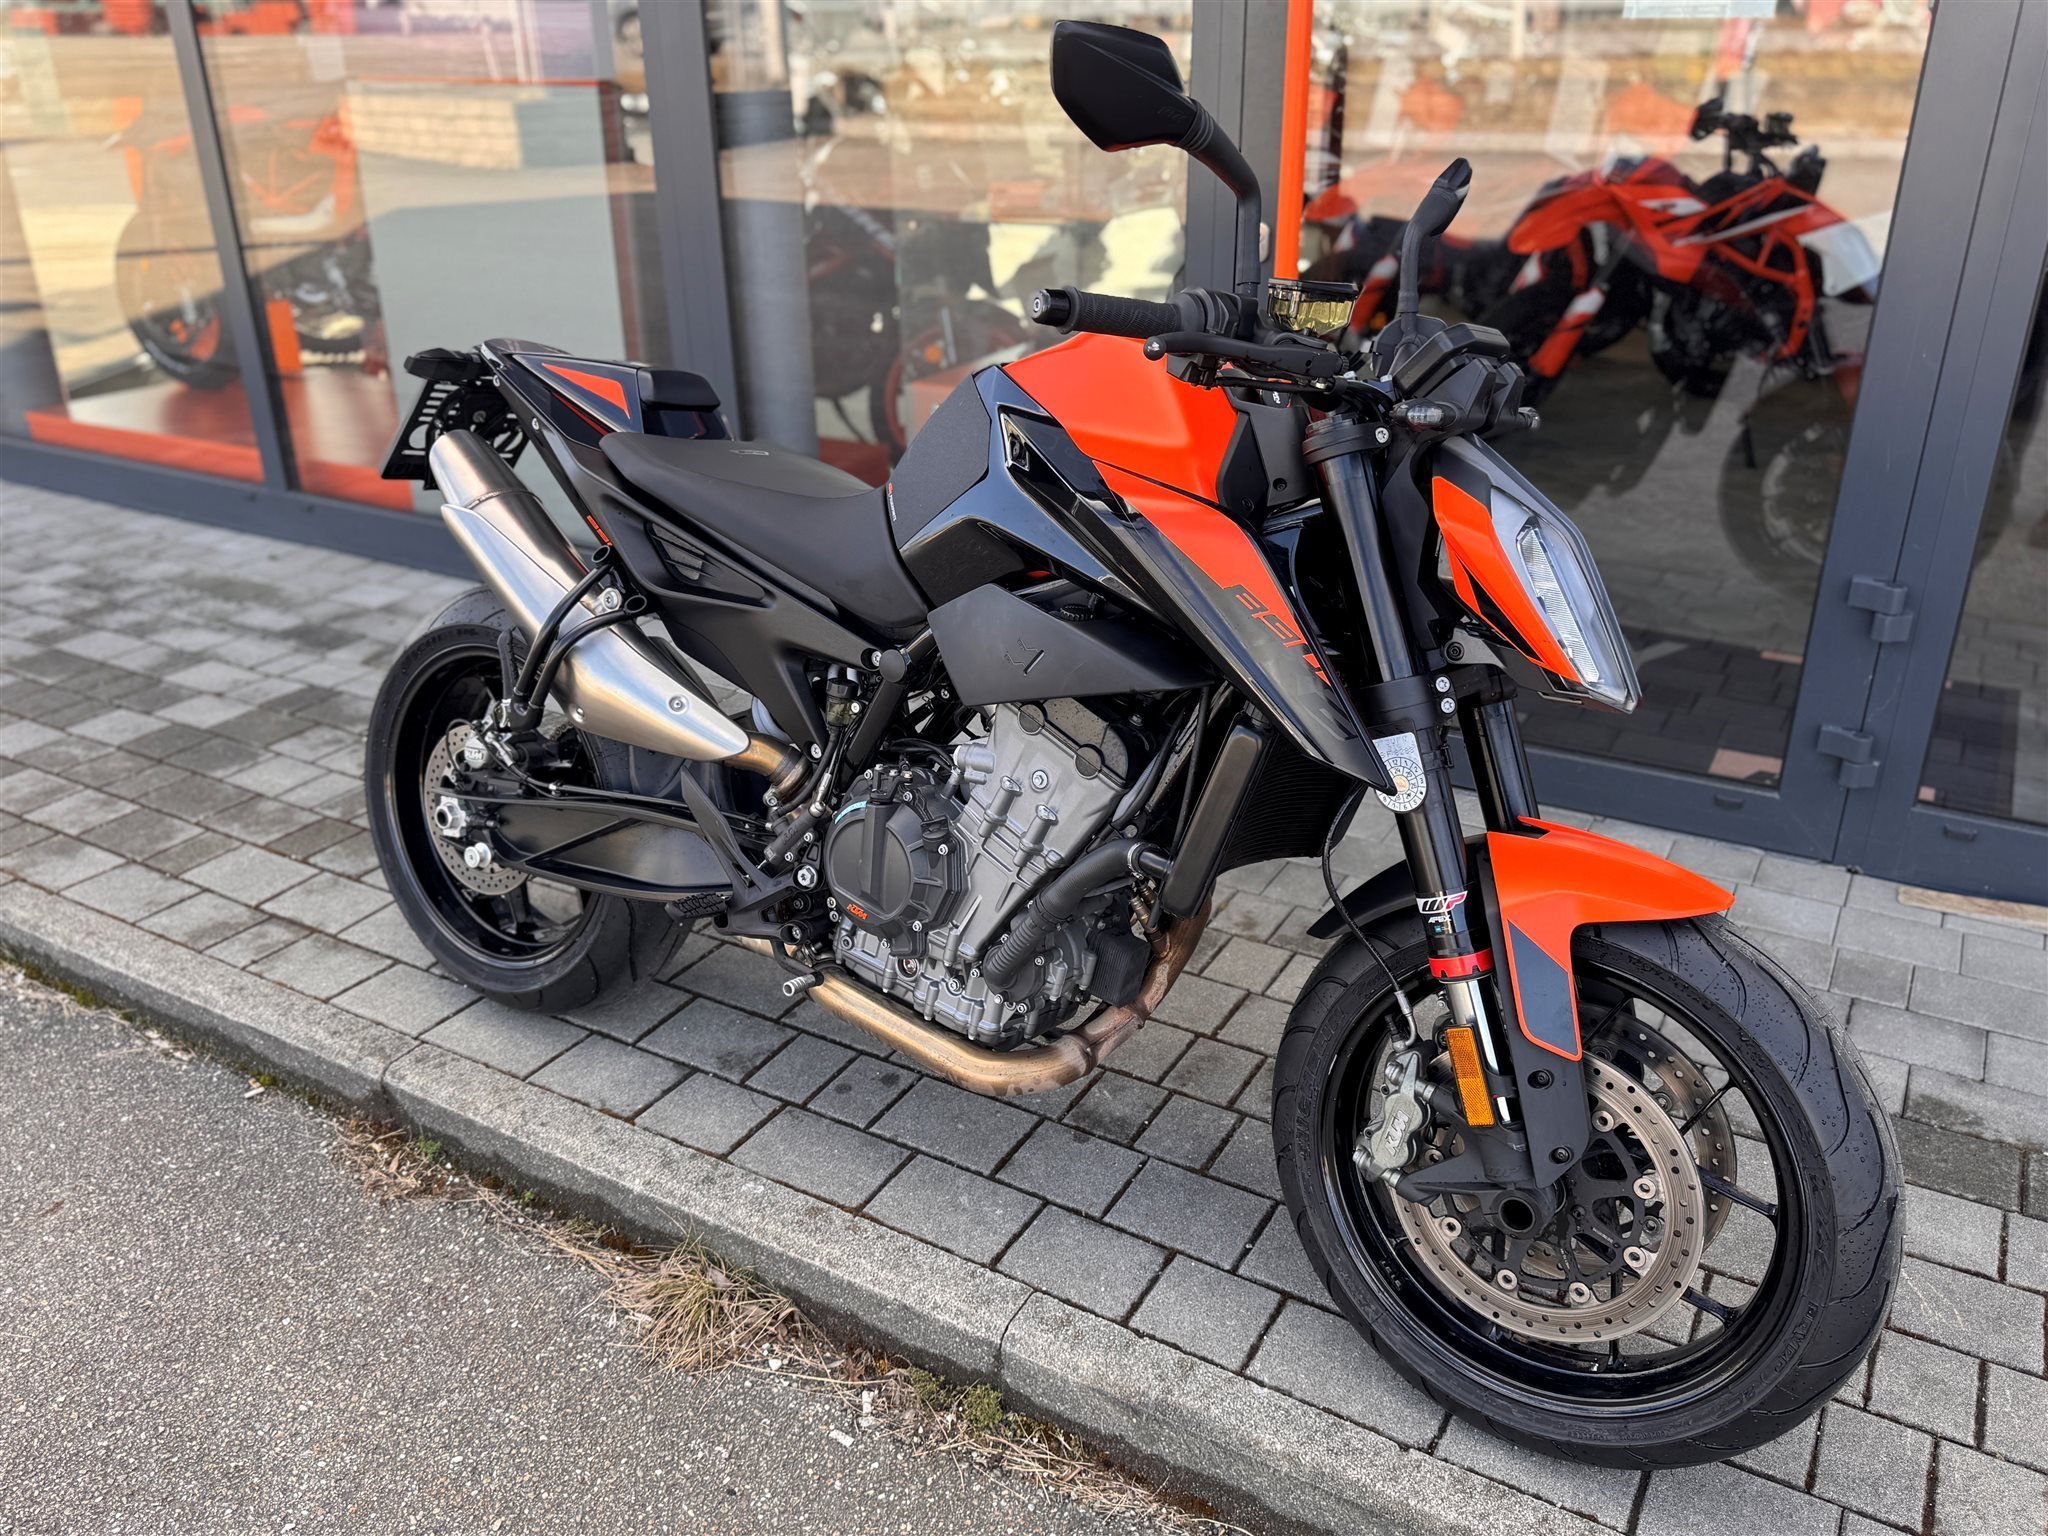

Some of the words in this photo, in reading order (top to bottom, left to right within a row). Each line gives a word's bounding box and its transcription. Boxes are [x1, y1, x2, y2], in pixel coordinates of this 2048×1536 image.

[1422, 893, 1466, 911] WP
[846, 903, 869, 920] KTM
[1428, 914, 1452, 924] APEX
[1384, 1111, 1410, 1157] KTM
